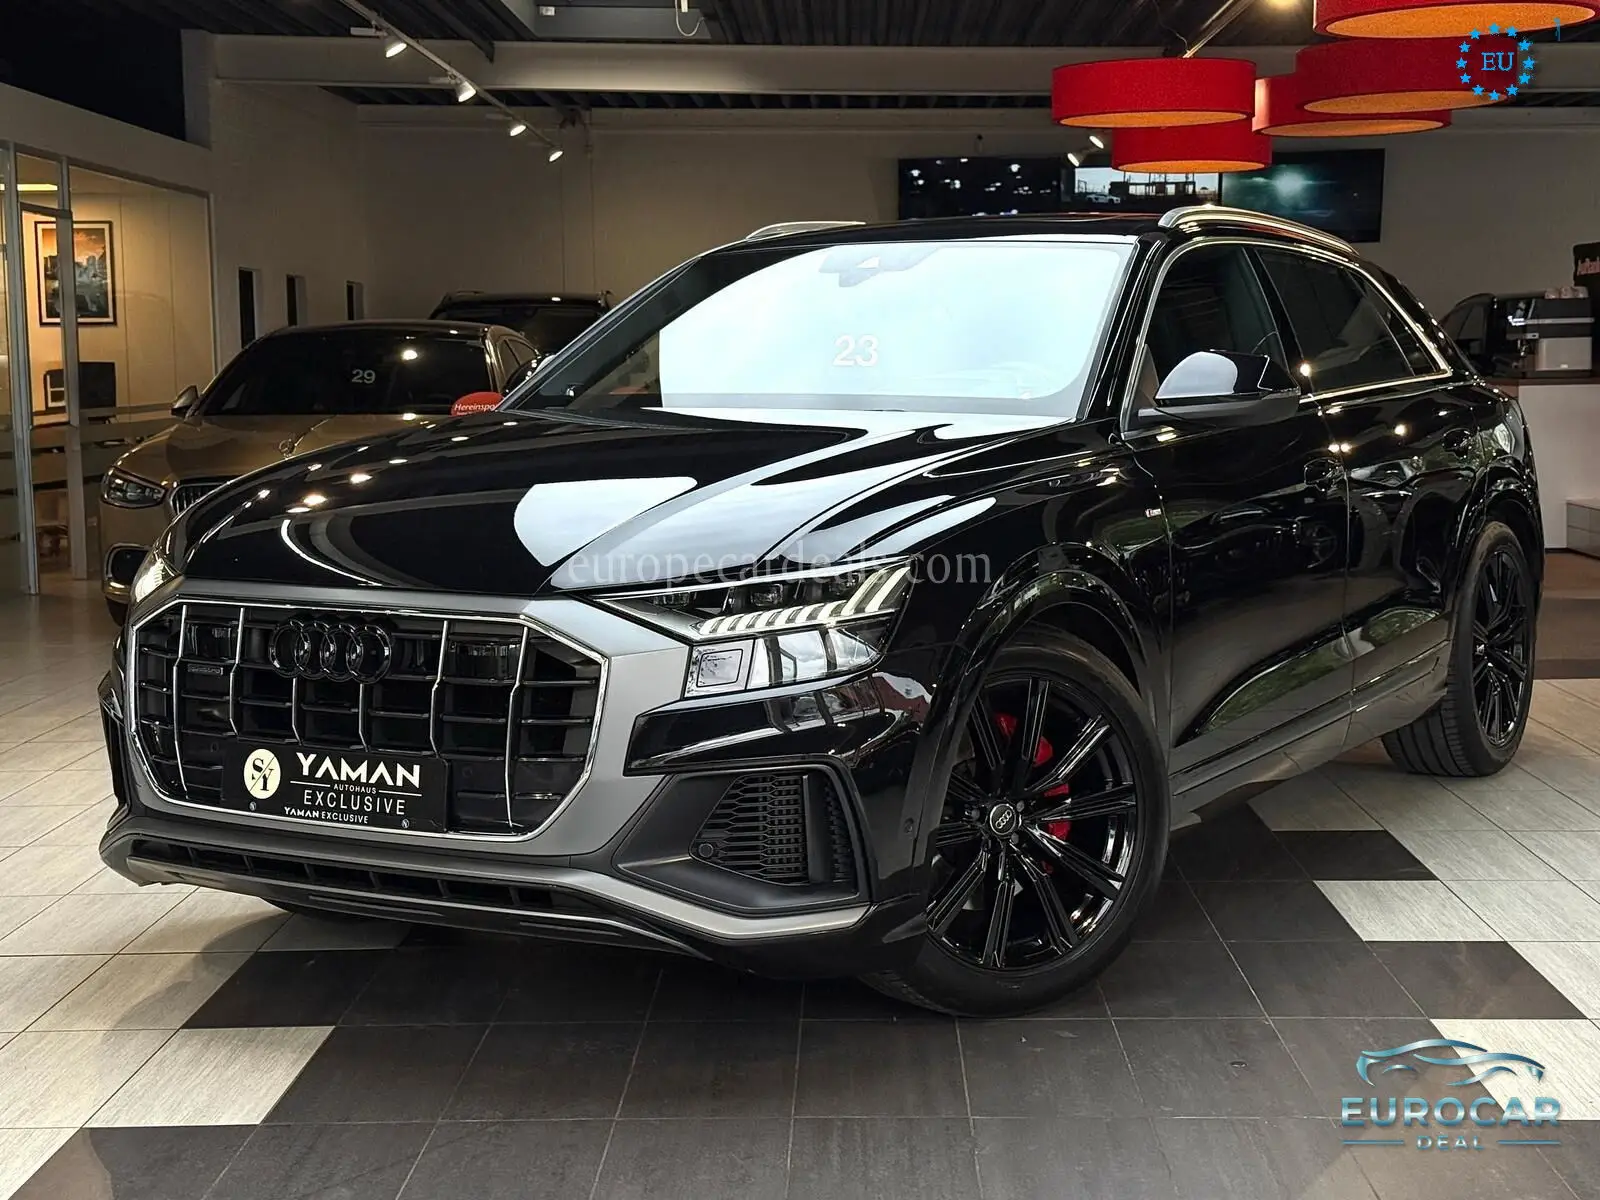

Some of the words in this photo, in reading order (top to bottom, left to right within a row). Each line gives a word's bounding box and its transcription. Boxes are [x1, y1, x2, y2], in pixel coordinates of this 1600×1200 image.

[832, 333, 879, 367] 23
[351, 369, 376, 384] 29
[296, 752, 420, 788] YAMAN
[333, 783, 377, 795] AUTOHAUS
[303, 790, 406, 815] EXCLUSIVE
[284, 806, 320, 819] YAMAN
[321, 811, 369, 824] EXCLUSIVE
